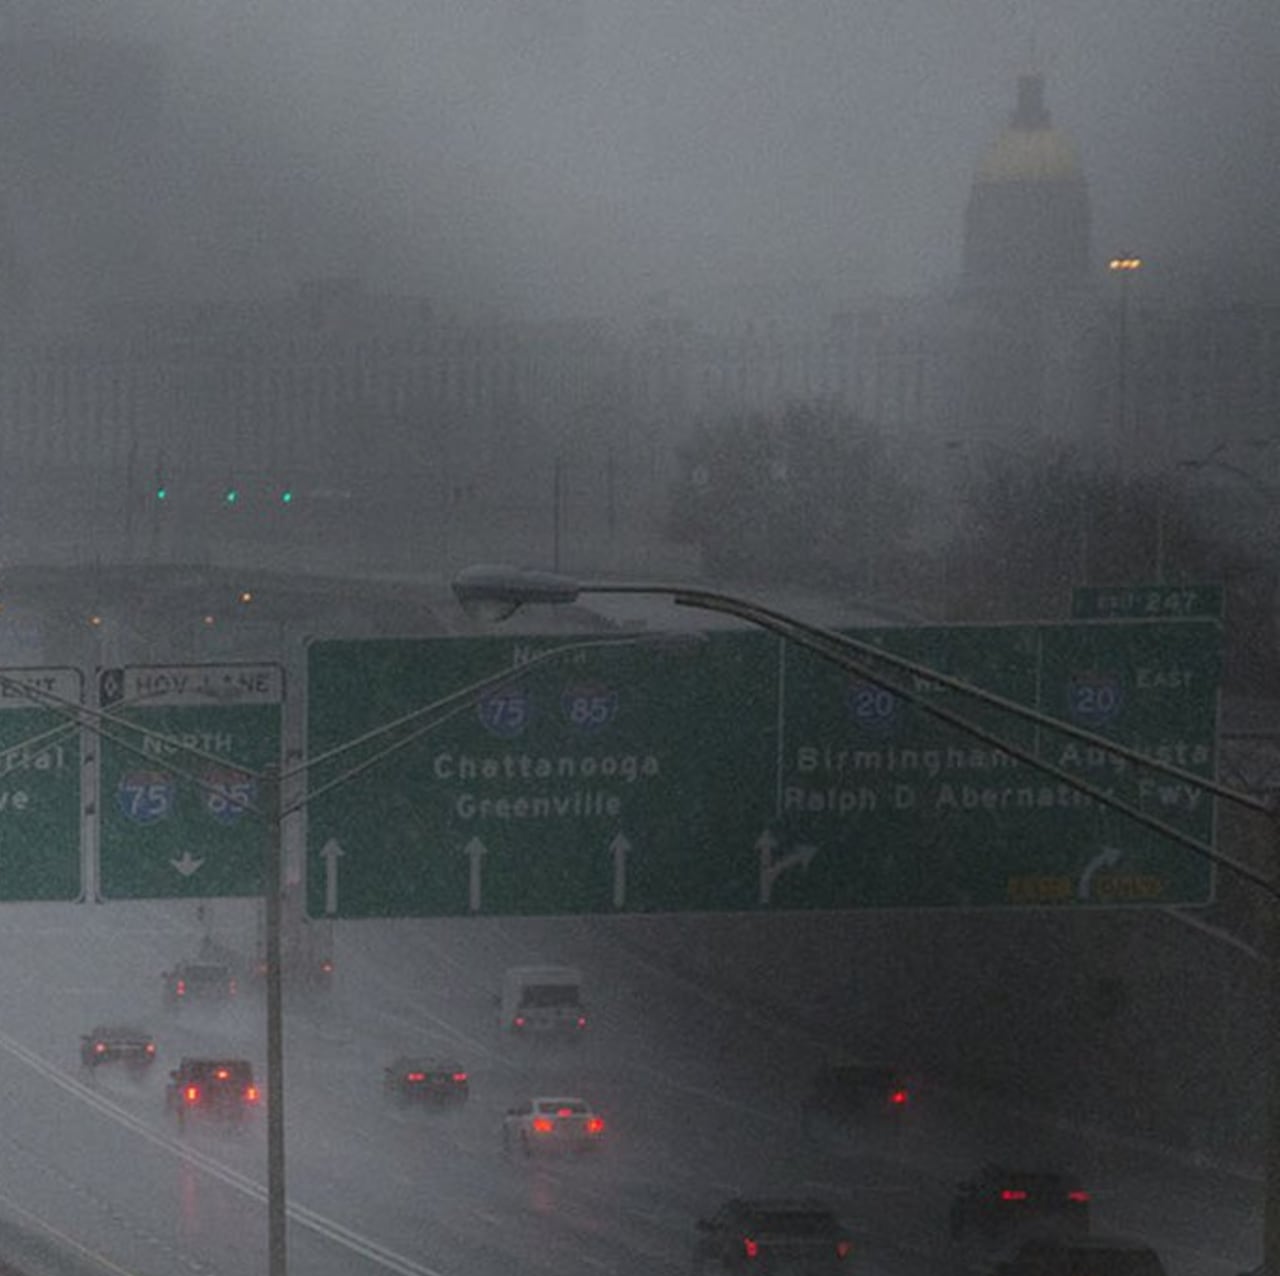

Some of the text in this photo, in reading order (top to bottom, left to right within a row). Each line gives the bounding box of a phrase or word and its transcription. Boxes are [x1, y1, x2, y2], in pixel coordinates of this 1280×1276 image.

[1144, 592, 1197, 613] 247
[136, 675, 189, 697] HOV
[1076, 668, 1194, 713] 20 EAST
[490, 697, 608, 726] 75 85
[856, 690, 894, 717] 20
[142, 733, 232, 754] NORTH
[433, 754, 660, 783] Chattanooga
[796, 747, 1017, 777] Birmingham
[127, 784, 248, 814] 75 85
[456, 793, 621, 820] Greenville
[784, 787, 876, 814] Ralph
[895, 785, 915, 810] D
[1138, 777, 1201, 812] Fwy
